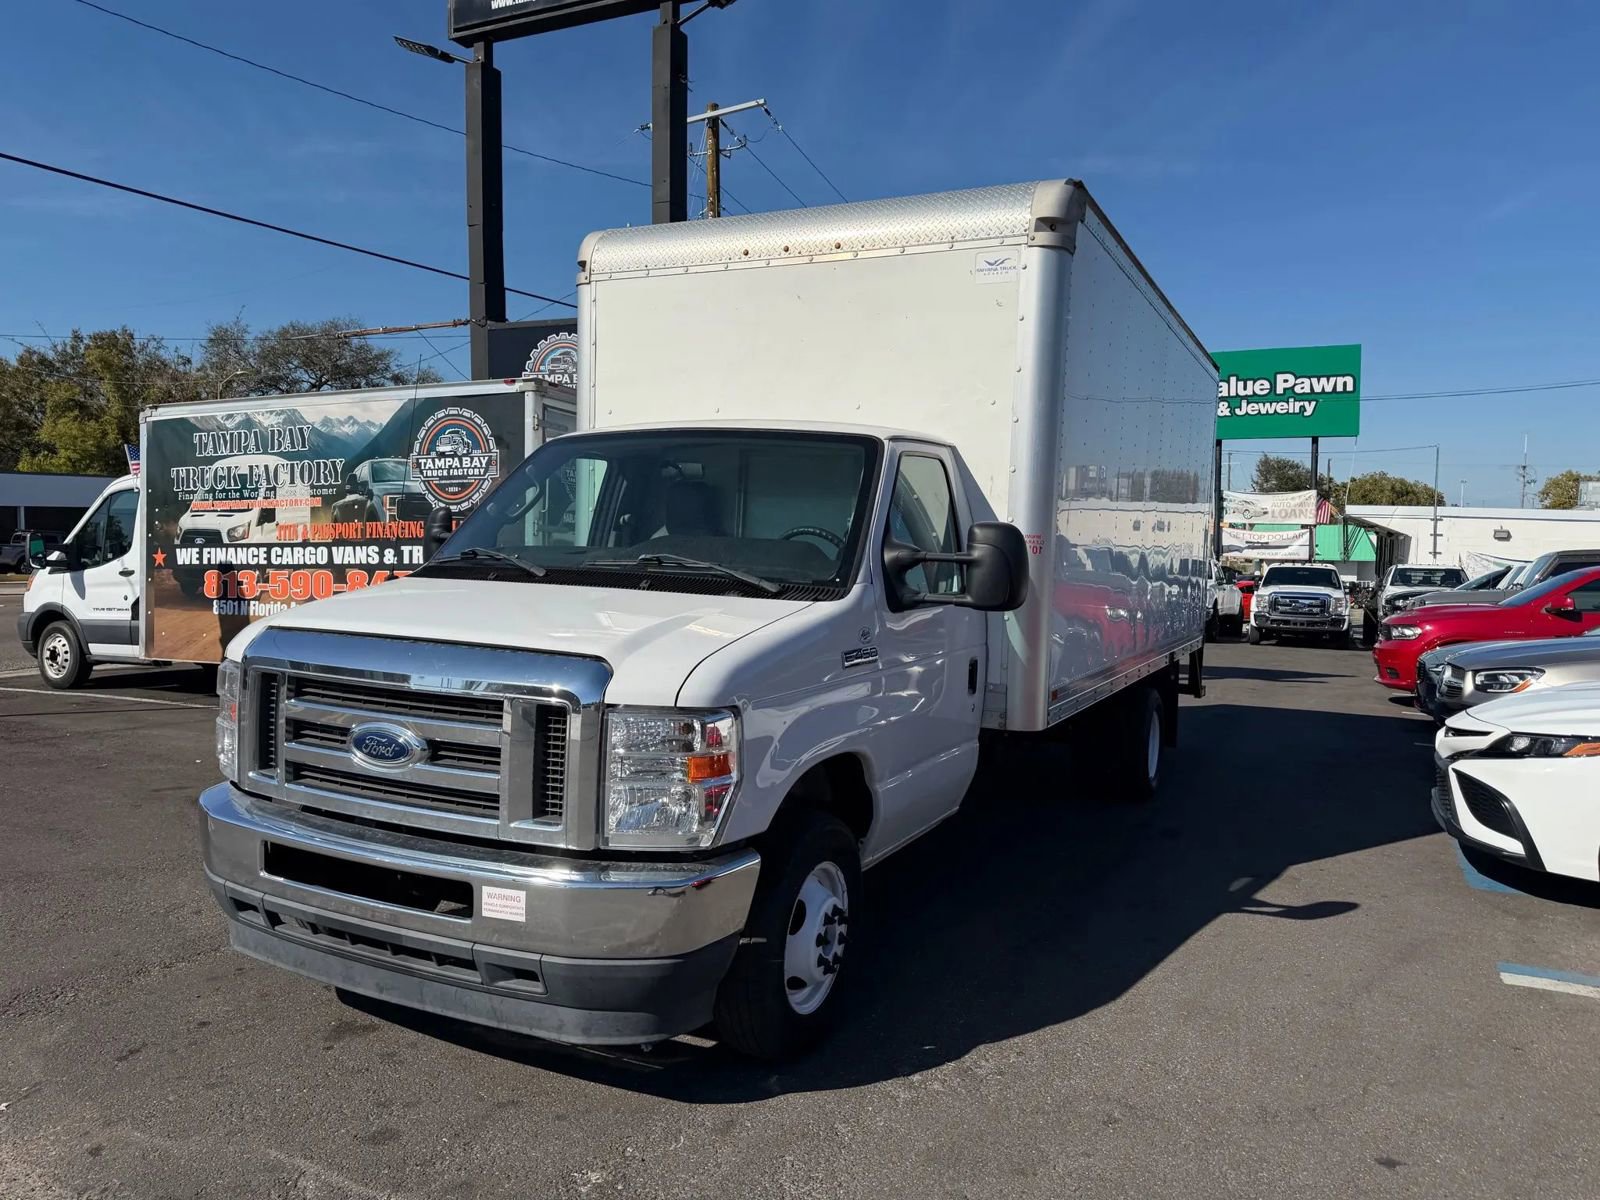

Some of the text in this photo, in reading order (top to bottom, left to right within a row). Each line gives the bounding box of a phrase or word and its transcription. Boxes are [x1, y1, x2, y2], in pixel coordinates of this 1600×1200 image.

[1218, 373, 1354, 397] alue Pawn
[1217, 398, 1316, 417] & Jewelry
[194, 425, 312, 456] TAMPA BAY
[419, 456, 489, 470] TAMPA BAY
[171, 459, 345, 491] TRUCK FACTORY
[422, 468, 485, 477] TRUCK FACTORY
[215, 489, 227, 499] for
[228, 490, 240, 498] the
[1271, 508, 1317, 519] LOANS
[312, 521, 364, 541] PASSPORT
[366, 520, 425, 540] FINANCING
[1249, 533, 1266, 541] TOP
[1267, 532, 1304, 541] DOLLAR
[176, 545, 424, 565] WE FINANCE CARGO VANS & TR
[213, 599, 238, 615] 8501
[241, 600, 248, 615] N
[250, 600, 287, 616] Florida
[362, 736, 397, 757] Ford
[487, 891, 521, 903] WARNING
